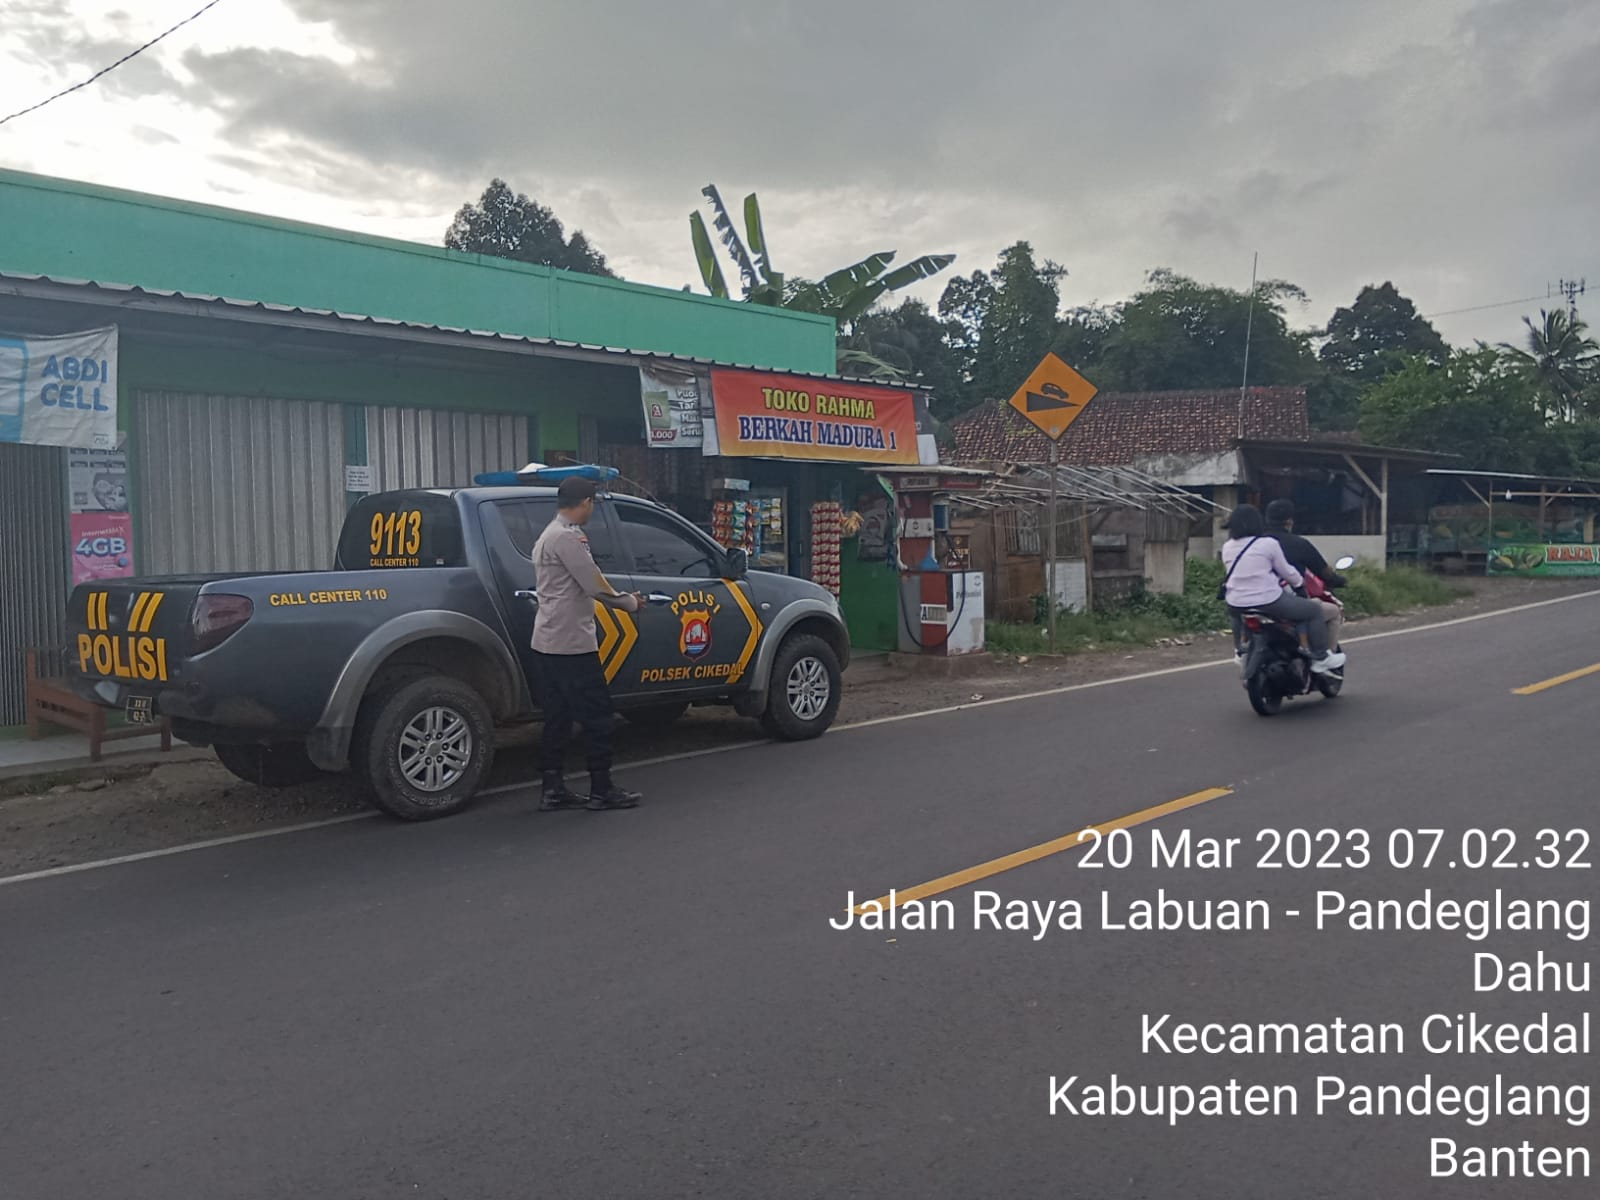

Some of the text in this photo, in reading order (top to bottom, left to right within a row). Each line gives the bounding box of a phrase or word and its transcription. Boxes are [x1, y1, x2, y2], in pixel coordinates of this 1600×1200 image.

[41, 354, 108, 384] ABDI
[40, 383, 109, 411] CELL
[761, 387, 876, 420] TOKO RAHMA
[737, 415, 897, 450] BERKAH MADURA 1
[76, 537, 127, 557] 4GB
[370, 510, 422, 556] 9113
[370, 558, 419, 567] CALL CENTER 110
[270, 588, 388, 607] CALL CENTER 110
[670, 590, 723, 615] POLISI
[77, 633, 168, 681] POLISI
[641, 664, 744, 682] POLSEK CIKEDAL
